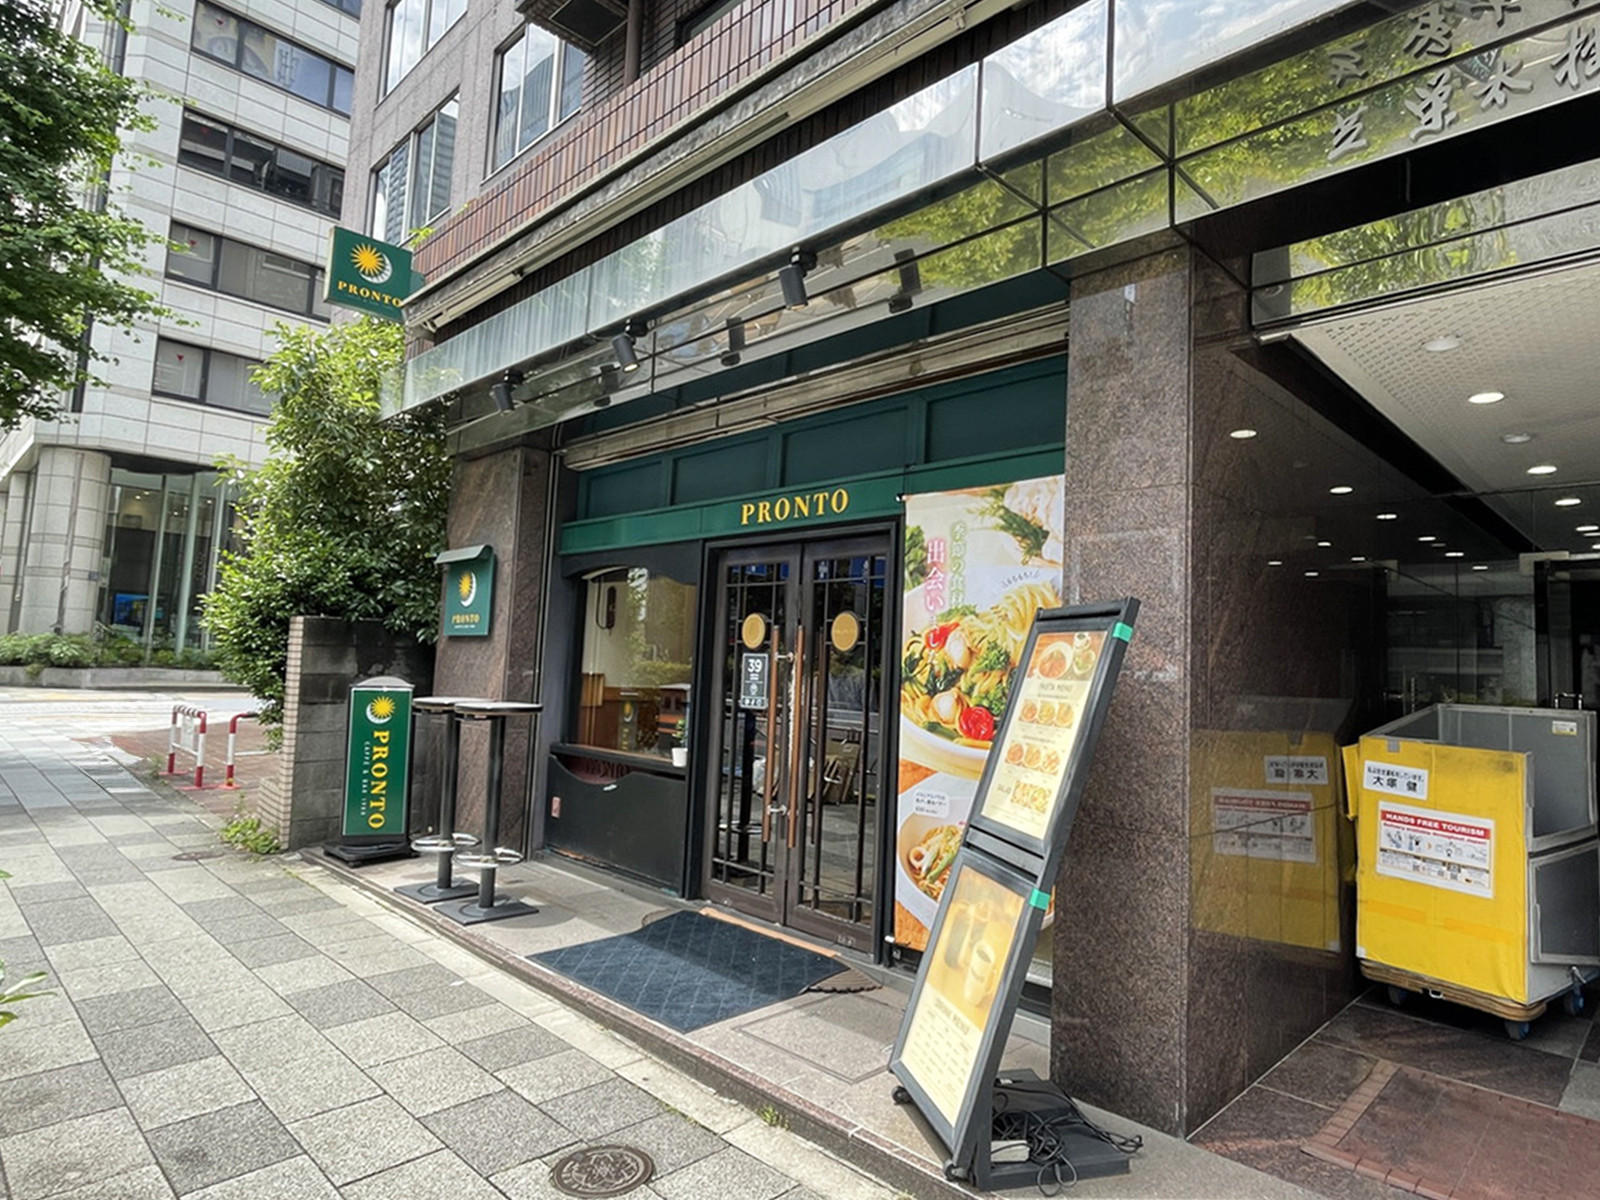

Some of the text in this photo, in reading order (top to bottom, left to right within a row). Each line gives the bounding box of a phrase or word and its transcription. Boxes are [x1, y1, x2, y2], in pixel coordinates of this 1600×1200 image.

[337, 281, 401, 308] PRONTO
[740, 488, 849, 525] PRONTO
[747, 659, 763, 673] 39
[368, 730, 390, 829] PRONTO
[1385, 812, 1485, 836] HANDS FREE TOURISM
